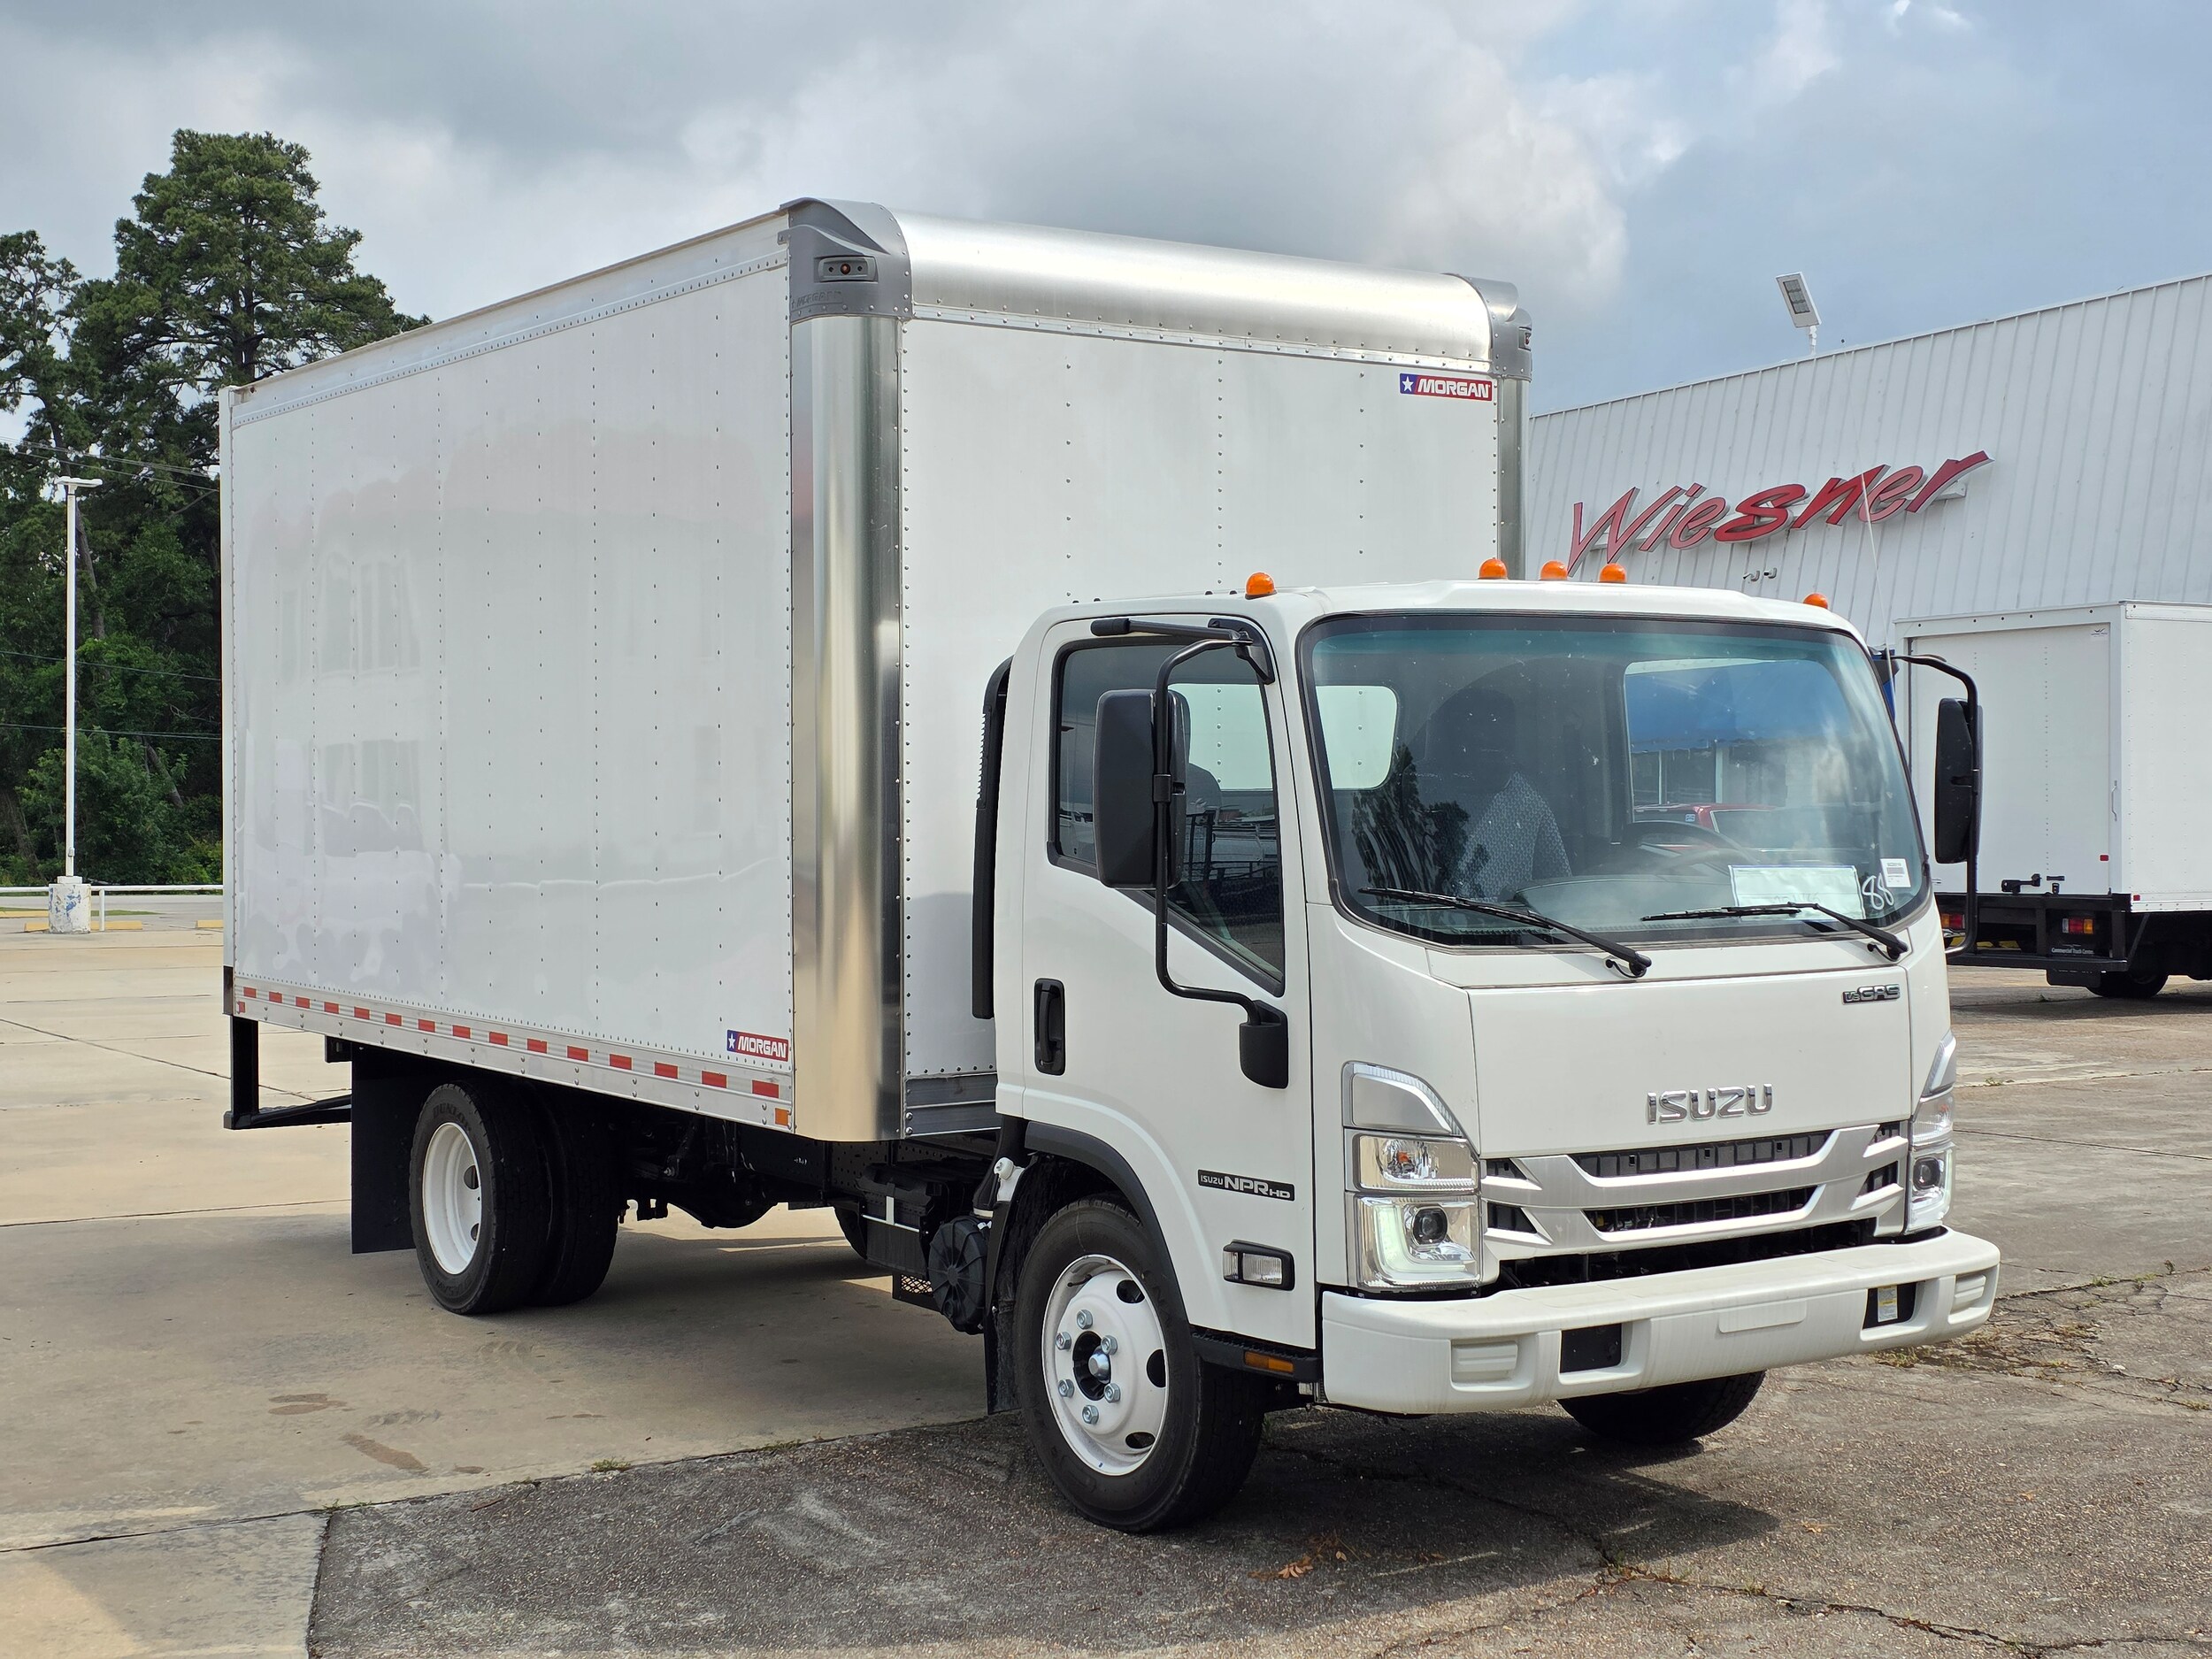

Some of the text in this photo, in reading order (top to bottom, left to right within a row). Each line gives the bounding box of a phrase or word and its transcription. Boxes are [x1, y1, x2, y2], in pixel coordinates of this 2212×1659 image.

[1417, 378, 1489, 398] MORGAN
[1567, 449, 1994, 577] Wiesner
[737, 1035, 787, 1058] MORGAN
[1647, 1082, 1773, 1125] ISUZU
[1200, 1174, 1224, 1186] ISUZU
[1269, 1188, 1291, 1199] HD
